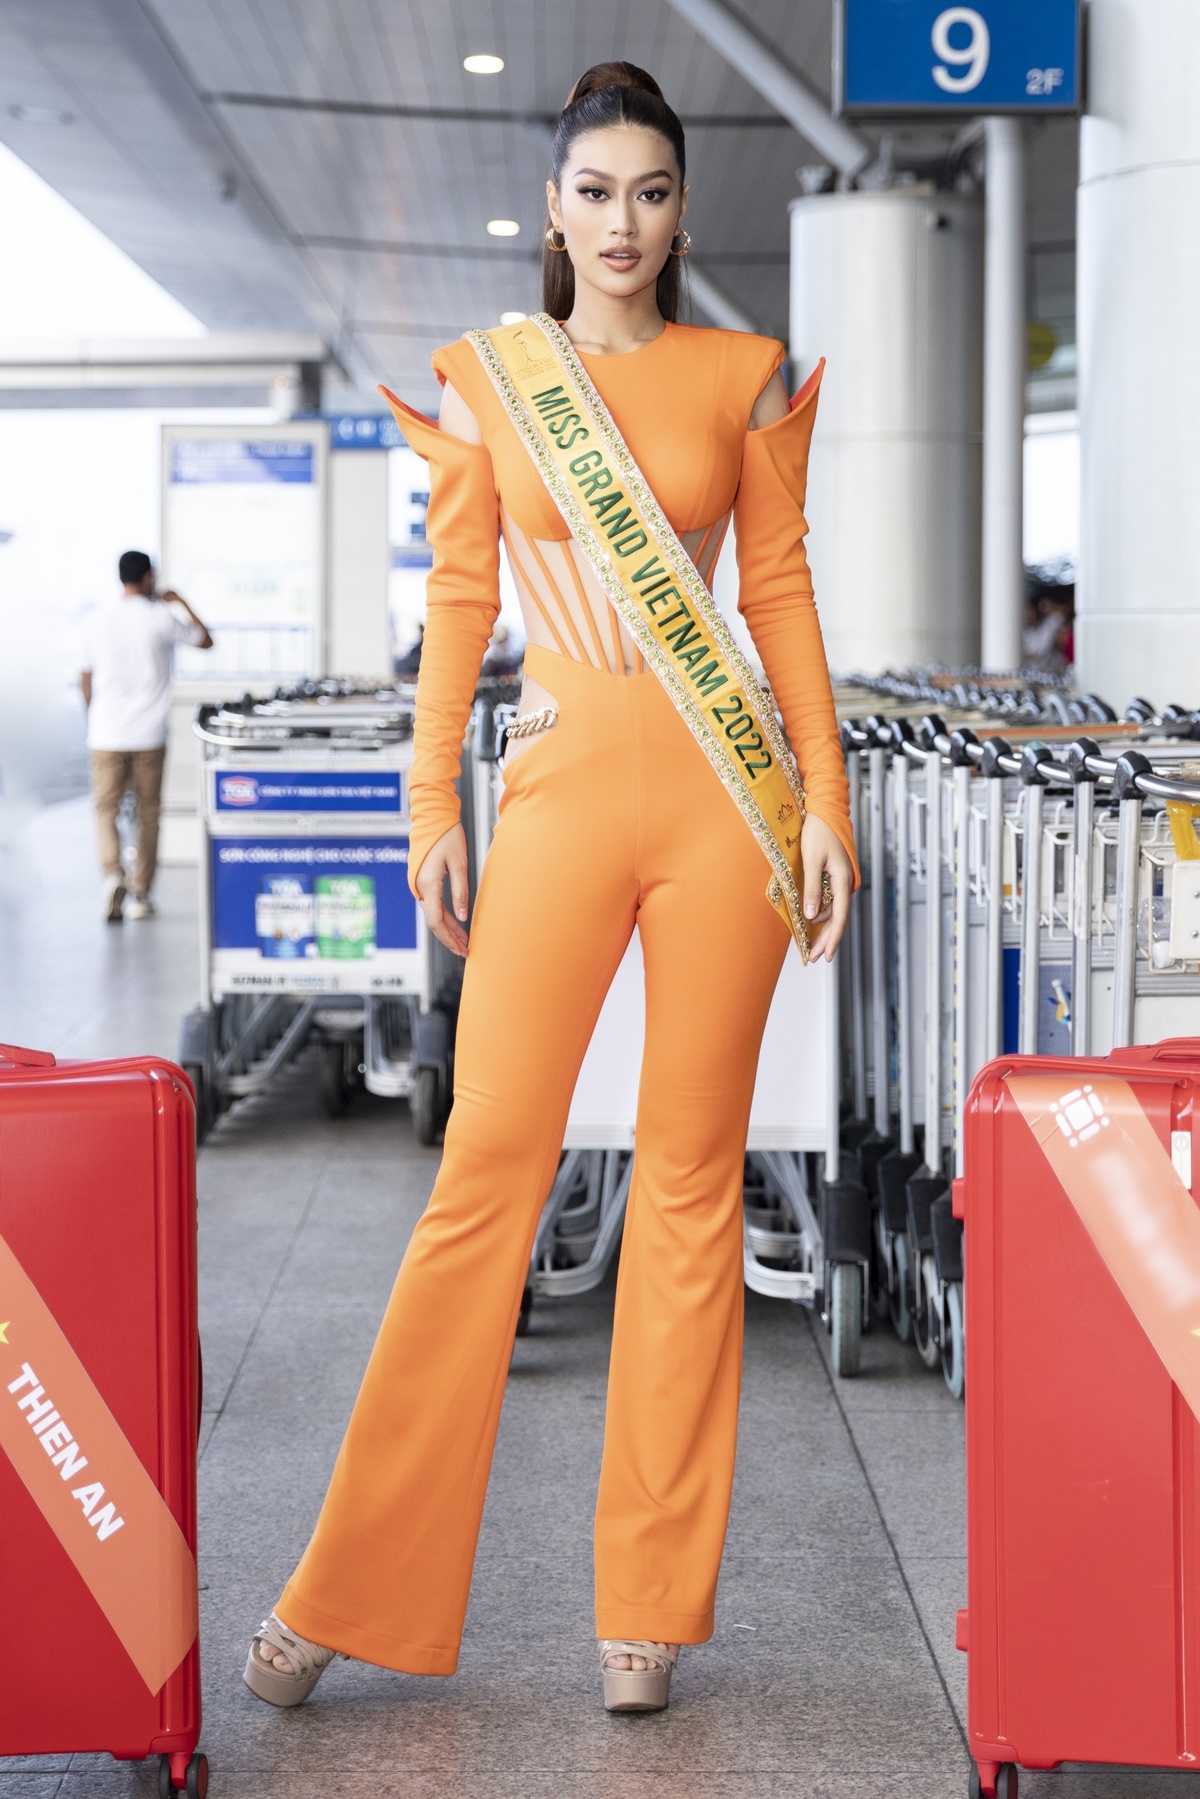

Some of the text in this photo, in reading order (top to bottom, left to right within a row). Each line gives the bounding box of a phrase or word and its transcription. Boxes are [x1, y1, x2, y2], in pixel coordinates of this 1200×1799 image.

[931, 6, 991, 94] 9
[1025, 68, 1064, 95] 2F
[531, 385, 590, 450] MISS
[569, 450, 648, 558] GRAND
[631, 555, 729, 697] VIETNAM
[711, 694, 773, 781] 2022
[7, 1362, 125, 1542] THIEN AN
